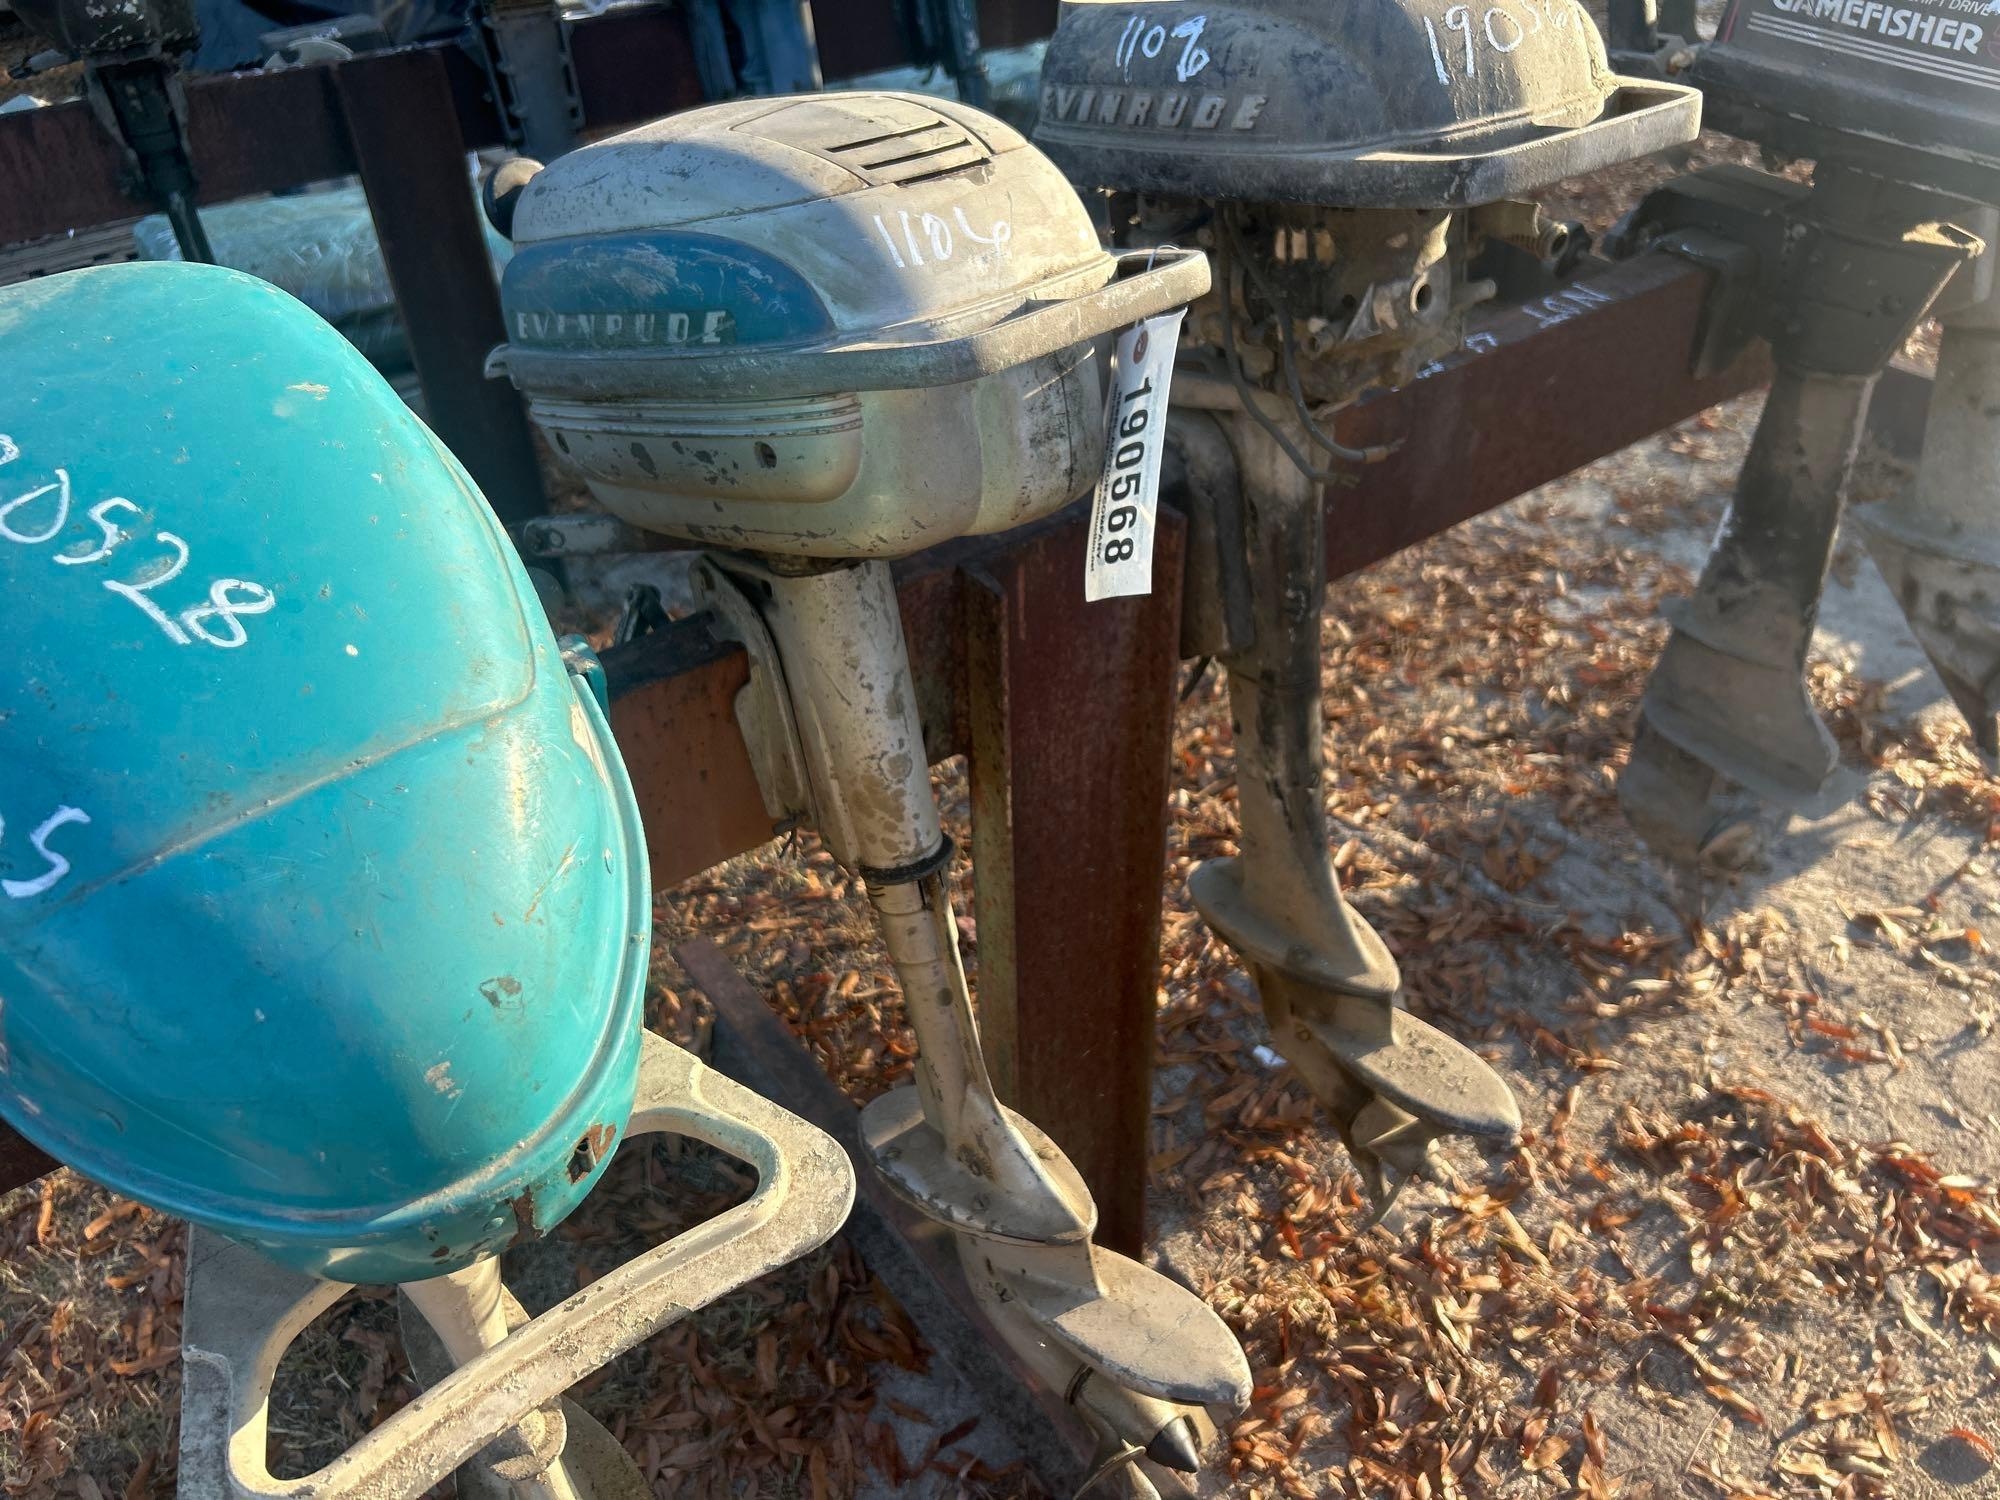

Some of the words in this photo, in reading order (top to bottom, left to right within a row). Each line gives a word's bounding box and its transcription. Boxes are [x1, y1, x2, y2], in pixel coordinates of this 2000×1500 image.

[873, 206, 1011, 267] 1106
[1104, 376, 1152, 565] 190568
[0, 806, 92, 899] 5
